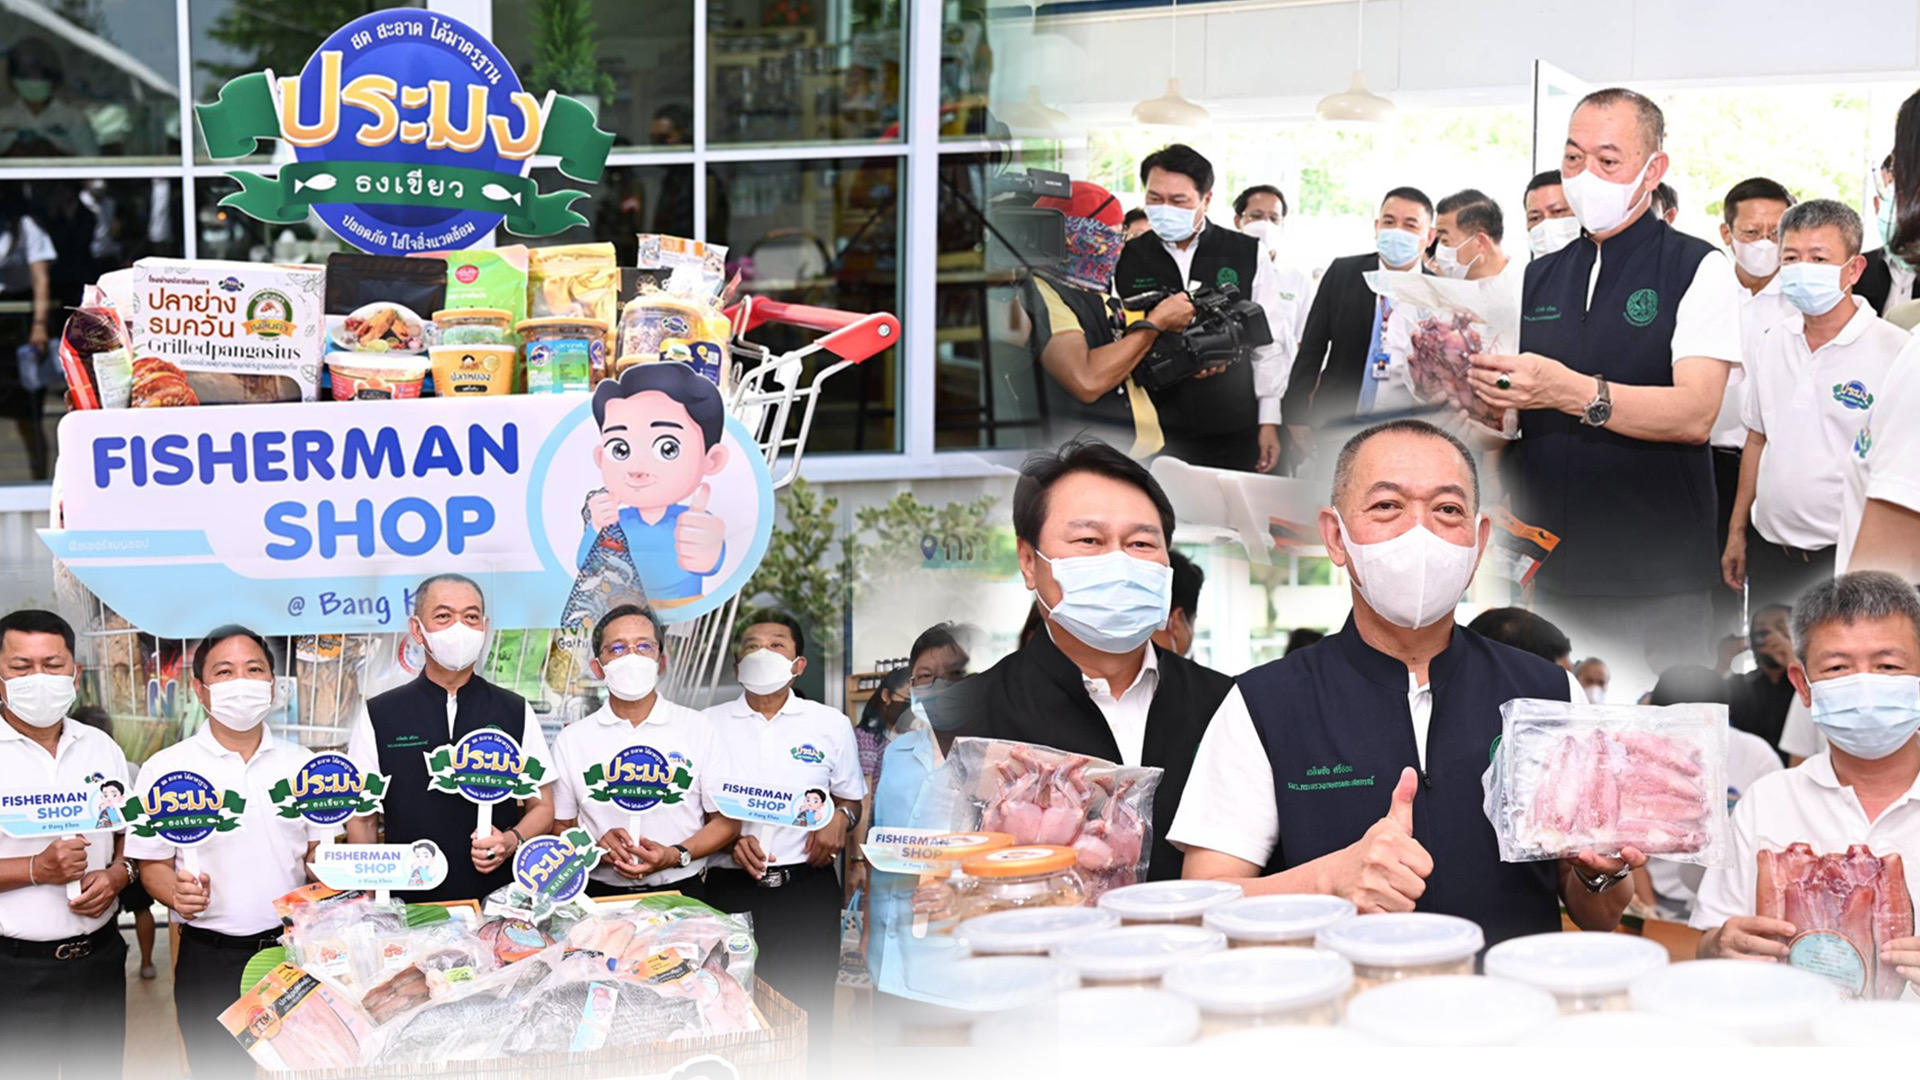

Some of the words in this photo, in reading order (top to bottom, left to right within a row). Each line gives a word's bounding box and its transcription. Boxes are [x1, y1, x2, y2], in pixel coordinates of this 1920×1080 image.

[350, 29, 373, 51] สด
[376, 20, 424, 41] สะอาด
[429, 16, 502, 86] ได้มาตรฐาน
[277, 50, 543, 159] ประมง
[355, 167, 465, 199] ธงเขียว
[341, 213, 388, 246] ปลอดภัย
[148, 287, 236, 314] ปลาย่าง
[149, 314, 235, 338] รมควัน
[147, 338, 302, 360] Grilledpangasius
[92, 422, 520, 488] FISHERMAN
[263, 495, 497, 562] SHOP
[287, 596, 306, 617] @
[318, 591, 391, 625] Bang
[451, 743, 525, 774] ประมง
[603, 756, 674, 784] ประมง
[291, 769, 365, 797] ประมง
[722, 783, 793, 801] FISHERMAN
[2, 792, 88, 807] FISHERMAN
[37, 805, 83, 819] SHOP
[142, 786, 224, 815] ประมง
[747, 798, 786, 812] SHOP
[875, 833, 950, 847] FISHERMAN
[901, 846, 943, 860] SHOP
[324, 851, 401, 861] FISHERMAN
[354, 862, 397, 874] SHOP
[518, 839, 575, 896] ประมง
